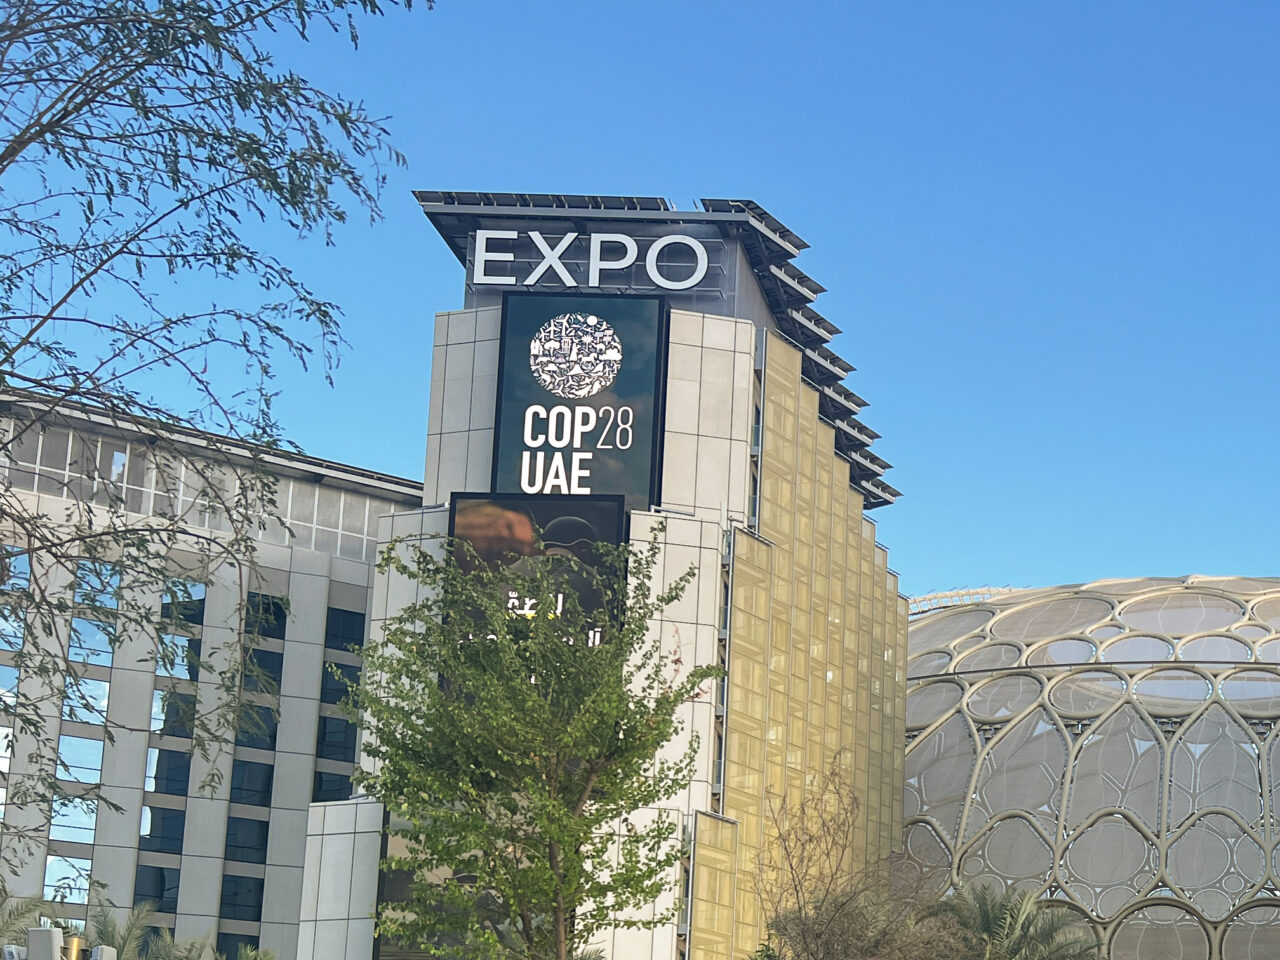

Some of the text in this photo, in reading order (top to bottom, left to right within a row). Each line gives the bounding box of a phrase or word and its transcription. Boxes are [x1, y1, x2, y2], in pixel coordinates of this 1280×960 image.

[473, 229, 709, 290] EXPO
[522, 404, 634, 450] COP28
[520, 451, 593, 495] UAE
